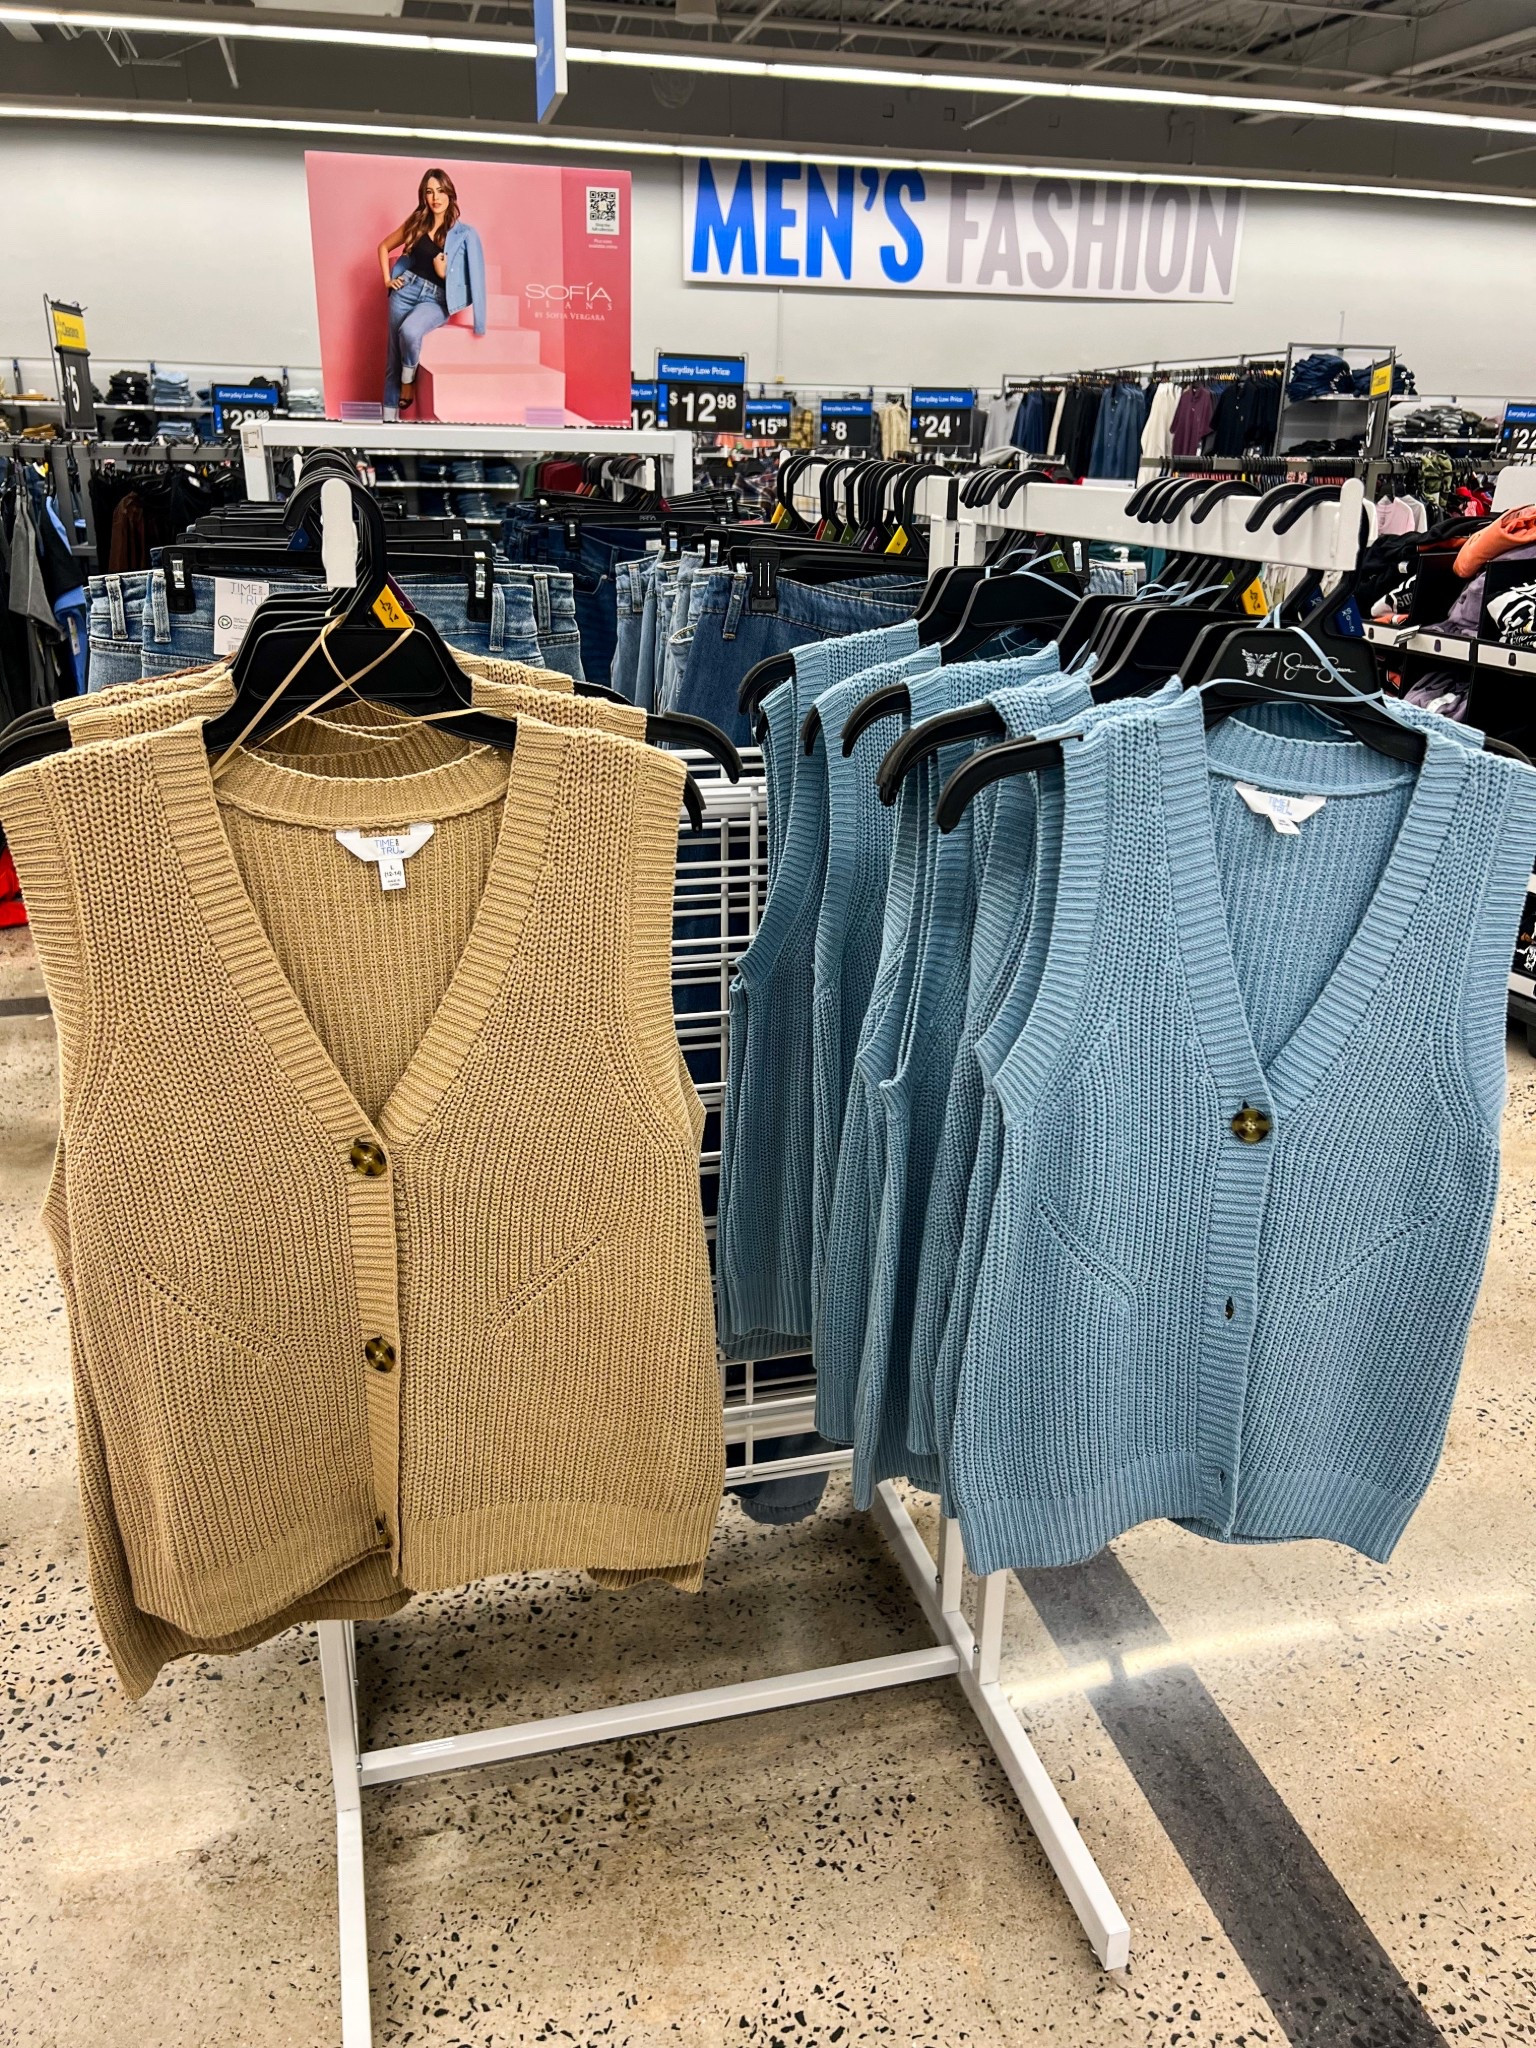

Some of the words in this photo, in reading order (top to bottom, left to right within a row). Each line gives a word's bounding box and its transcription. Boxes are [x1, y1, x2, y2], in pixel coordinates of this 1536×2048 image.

[691, 156, 926, 284] MEN'S
[946, 172, 1238, 296] FASHION
[525, 282, 612, 302] SOFÍA
[662, 364, 695, 376] Everyday
[696, 366, 710, 375] Low
[712, 366, 731, 376] Price
[374, 839, 394, 848] TIME
[381, 846, 399, 855] TRU
